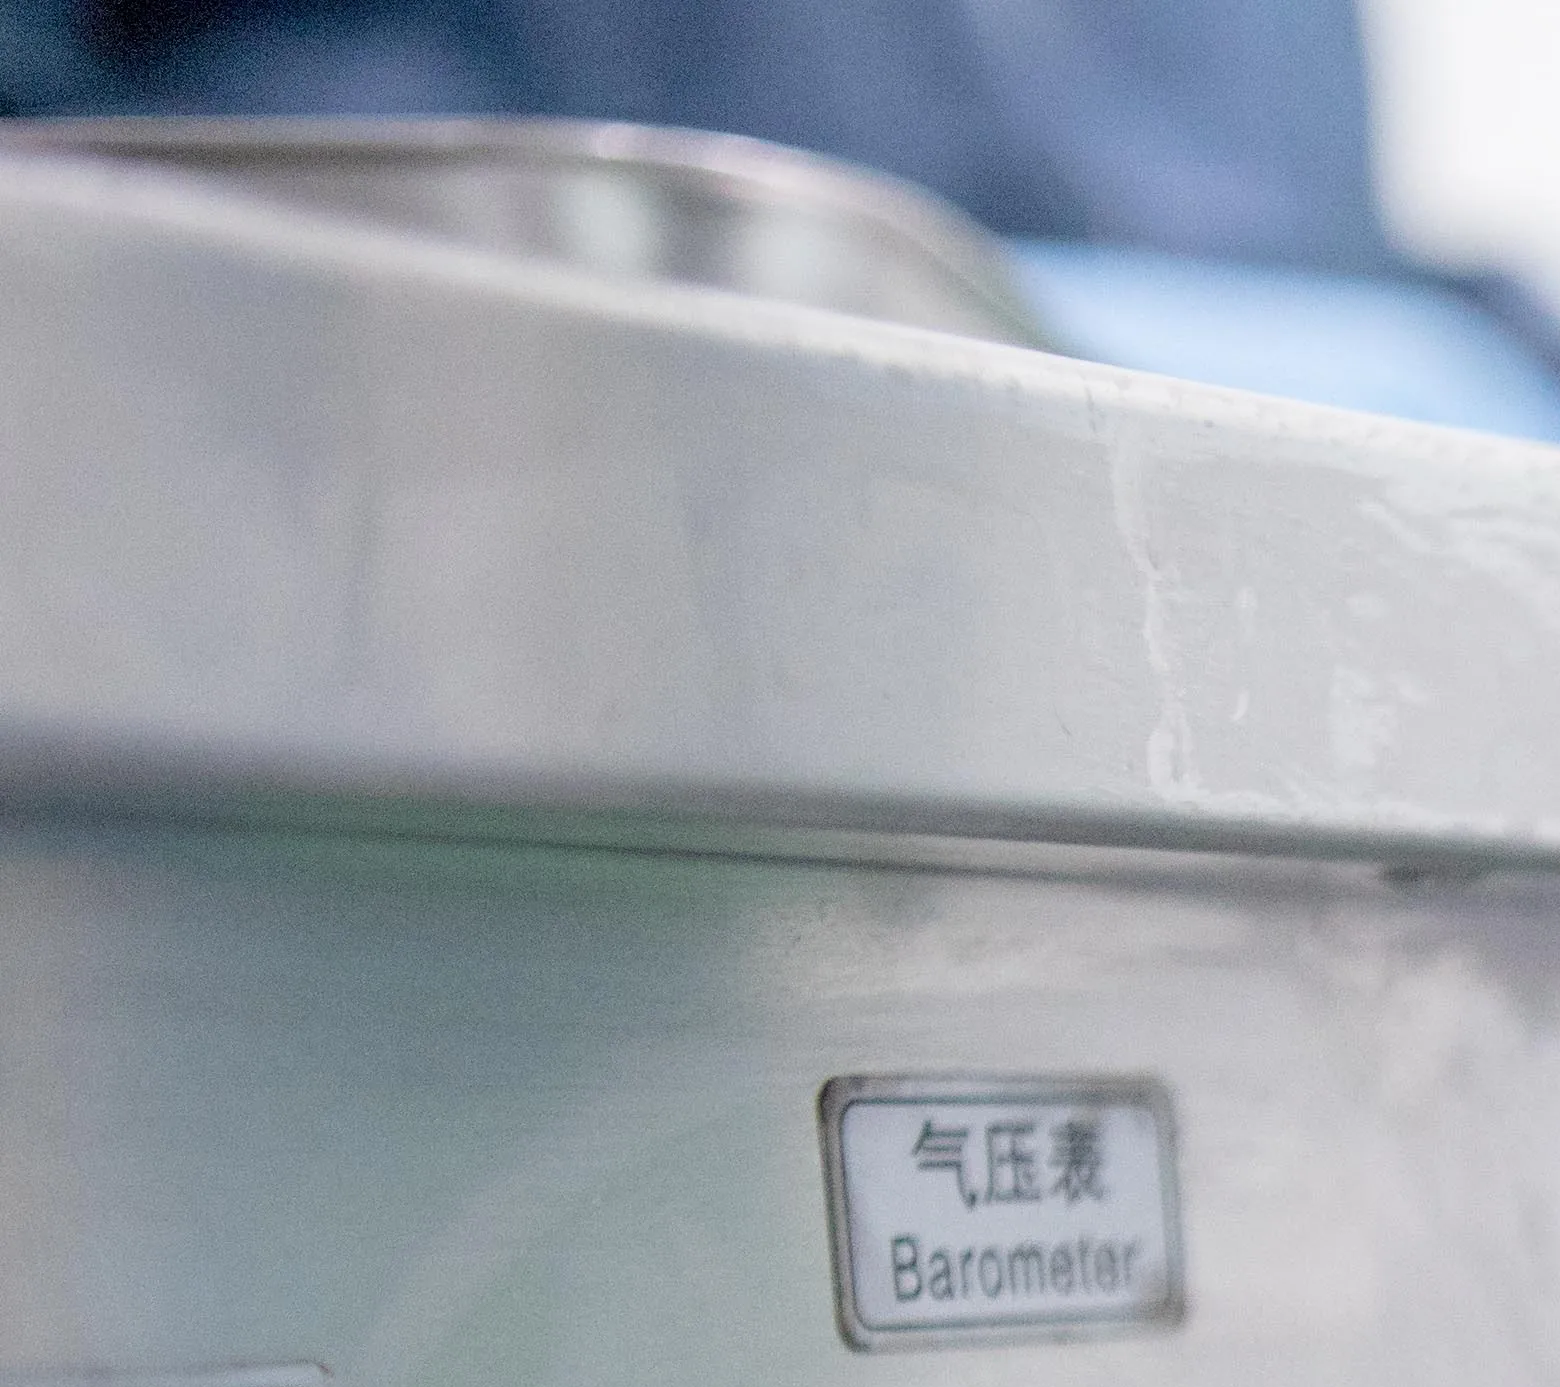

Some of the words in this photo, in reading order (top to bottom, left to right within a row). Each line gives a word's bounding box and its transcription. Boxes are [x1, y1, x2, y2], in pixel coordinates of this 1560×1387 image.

[911, 1119, 1107, 1211] 气压表
[891, 1232, 1139, 1302] Barometer
